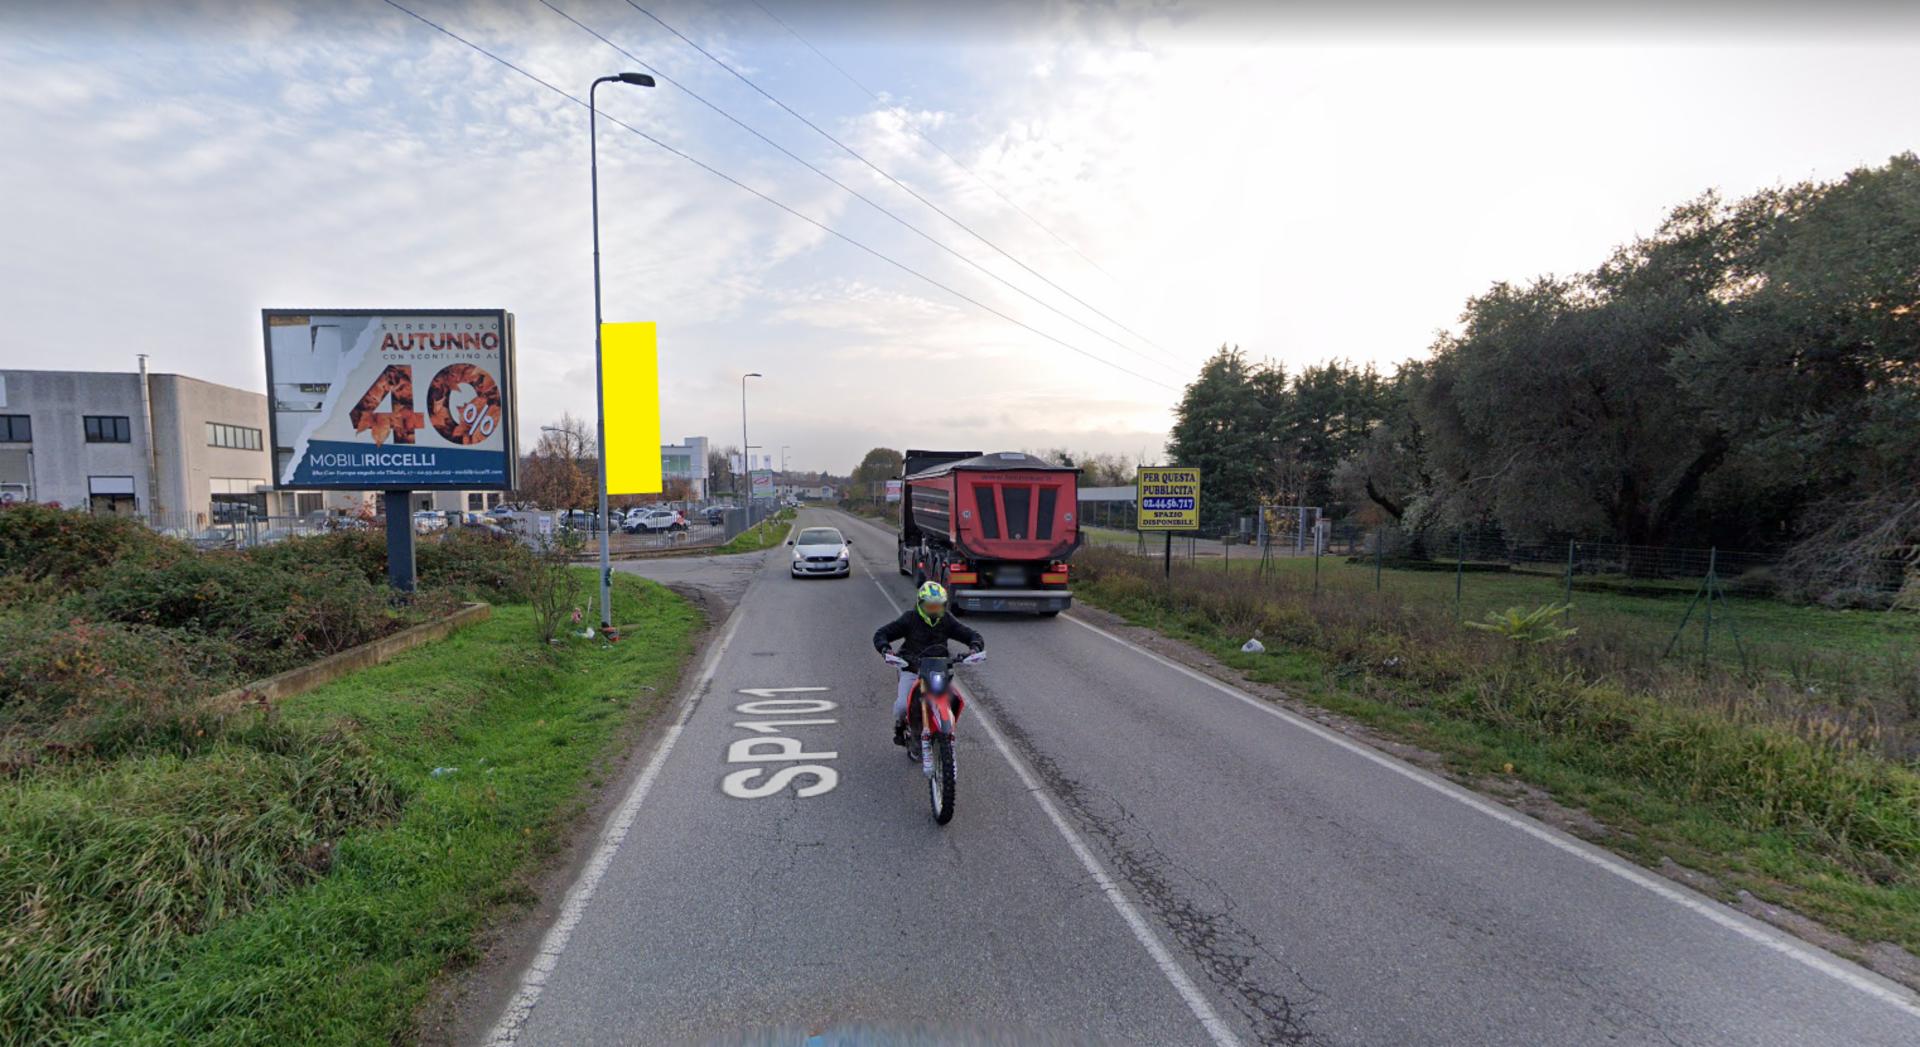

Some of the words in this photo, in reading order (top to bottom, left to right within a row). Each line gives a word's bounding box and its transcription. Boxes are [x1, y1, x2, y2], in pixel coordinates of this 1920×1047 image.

[381, 322, 498, 331] STREPITOSO
[381, 332, 499, 351] AUTUNNO
[349, 363, 502, 446] 40%
[310, 453, 436, 467] MOBILIRICCELLI
[1143, 473, 1160, 482] PER
[1162, 473, 1196, 483] QUESTA
[723, 687, 839, 799] SP101
